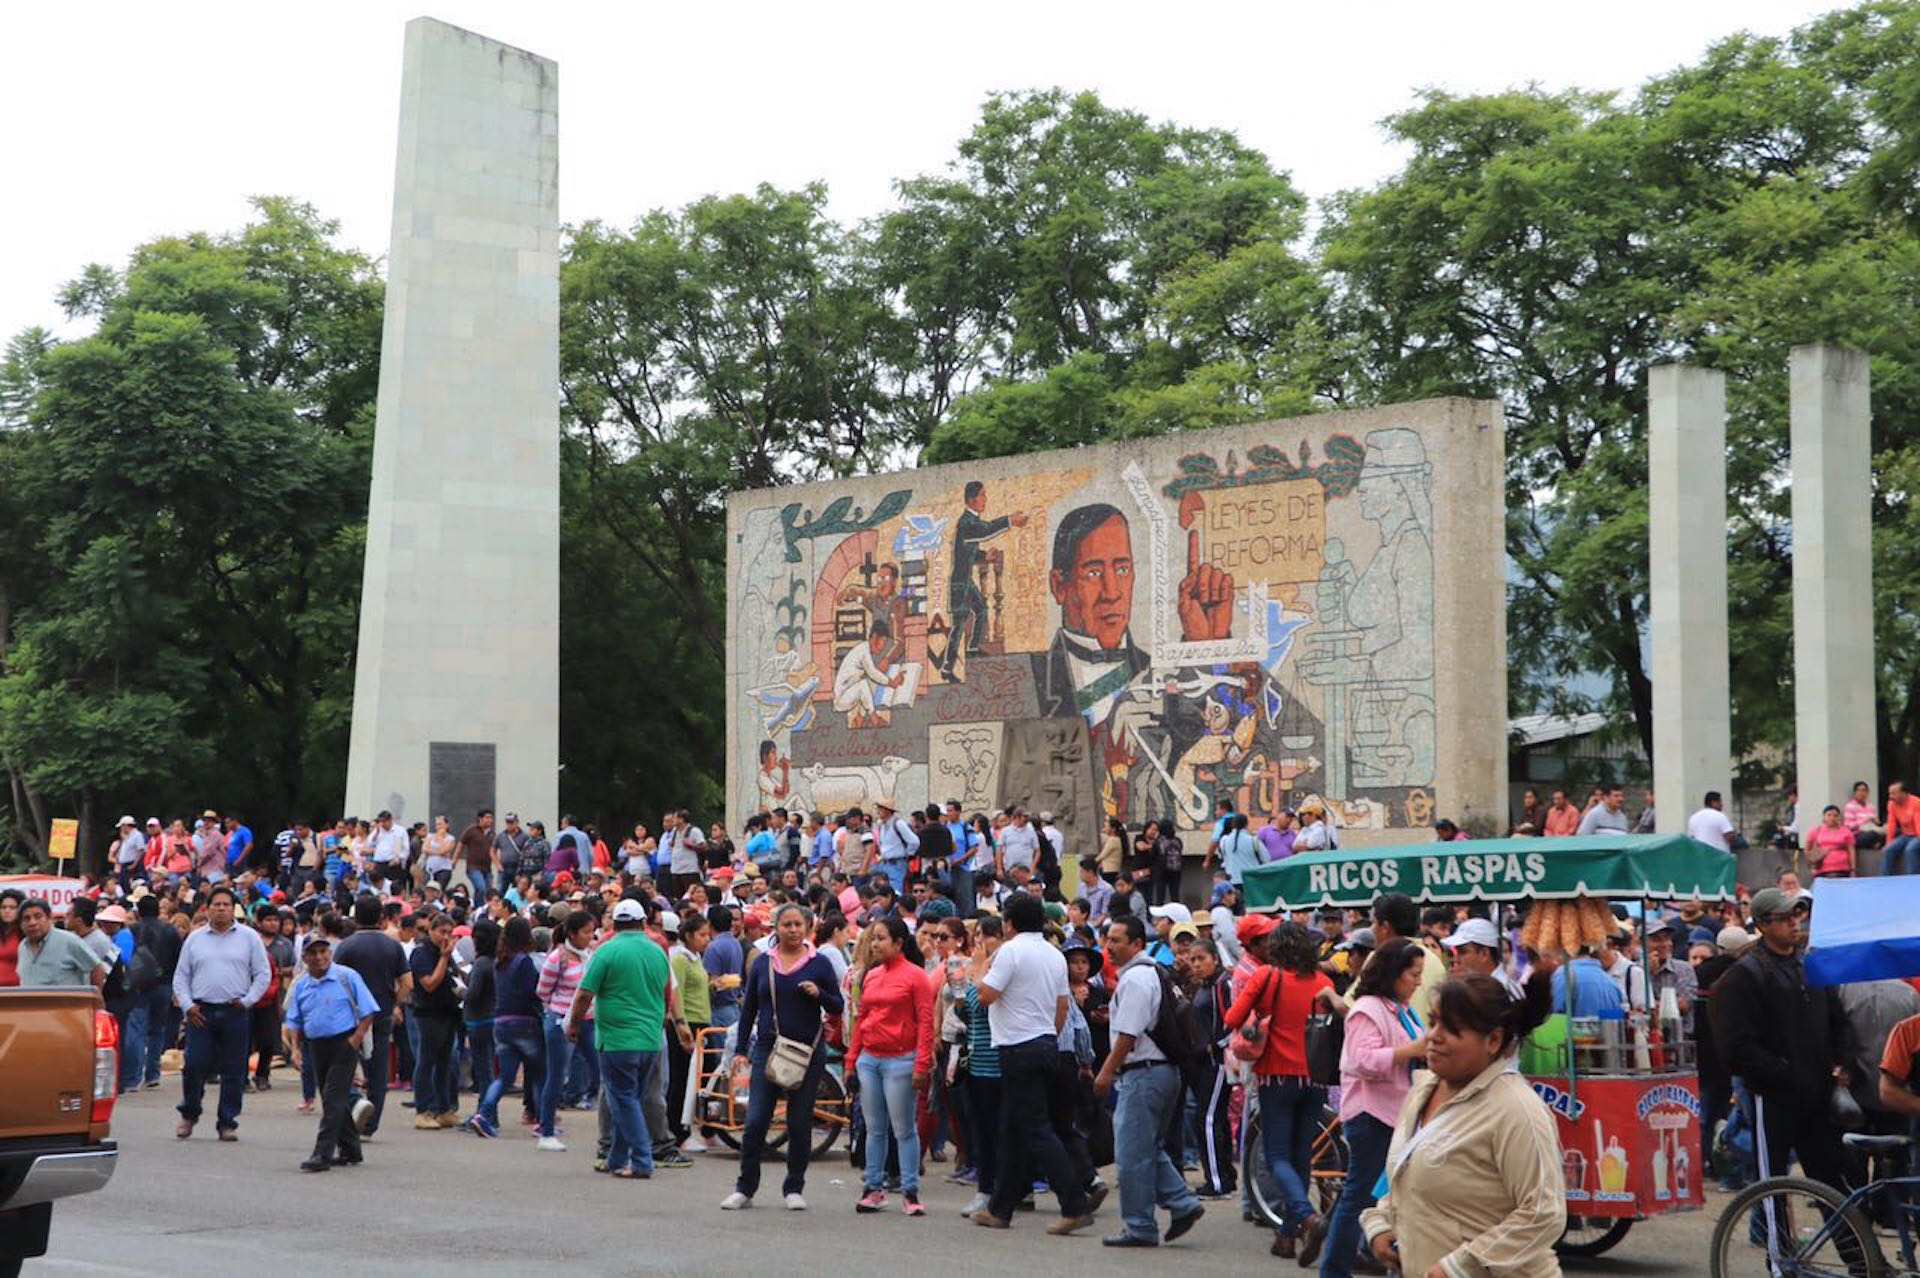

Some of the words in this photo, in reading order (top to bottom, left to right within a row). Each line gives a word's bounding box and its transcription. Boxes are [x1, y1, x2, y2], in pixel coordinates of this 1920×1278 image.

[1211, 499, 1276, 531] LEYES
[1287, 493, 1320, 521] DE
[1211, 532, 1321, 568] REFORMA
[1309, 859, 1399, 893] RICOS
[1421, 852, 1546, 886] RASPAS
